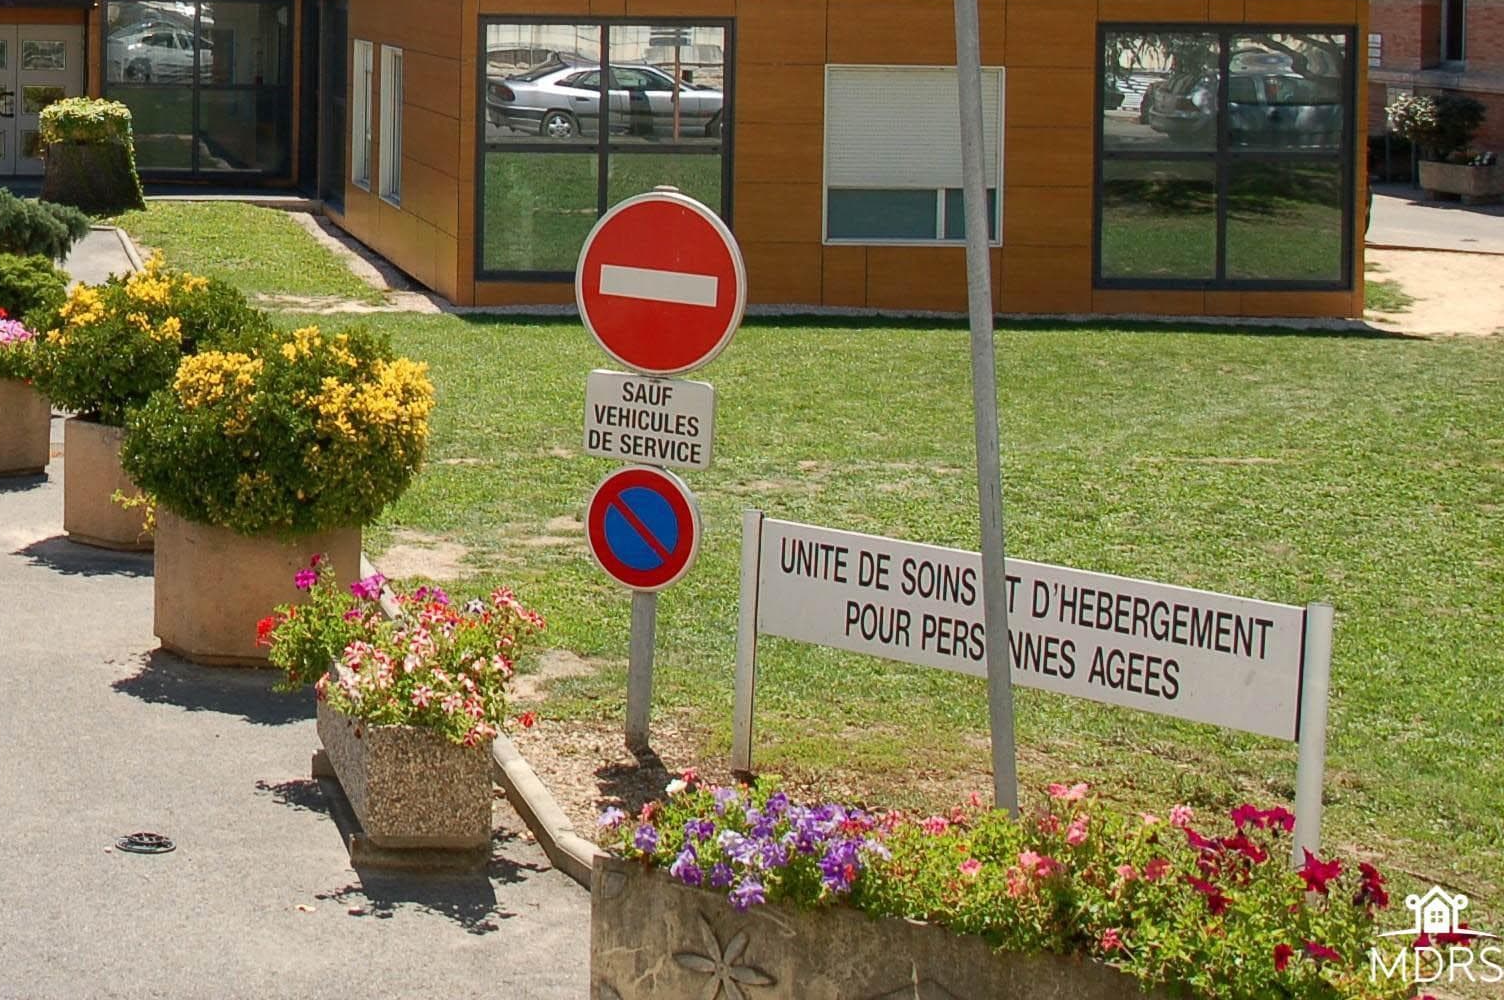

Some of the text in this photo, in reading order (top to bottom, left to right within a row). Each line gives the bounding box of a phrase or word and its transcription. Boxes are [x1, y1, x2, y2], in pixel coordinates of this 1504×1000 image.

[622, 381, 673, 406] SAUF
[594, 404, 699, 437] VEHICULES
[588, 429, 702, 464] DE SERVICE
[781, 537, 848, 583] UNITE
[858, 550, 890, 591] DE
[901, 558, 976, 606] SOINS
[1032, 580, 1273, 659] D'HEBERGEMENT
[846, 600, 1180, 700] POUR PERSNNES AGEES
